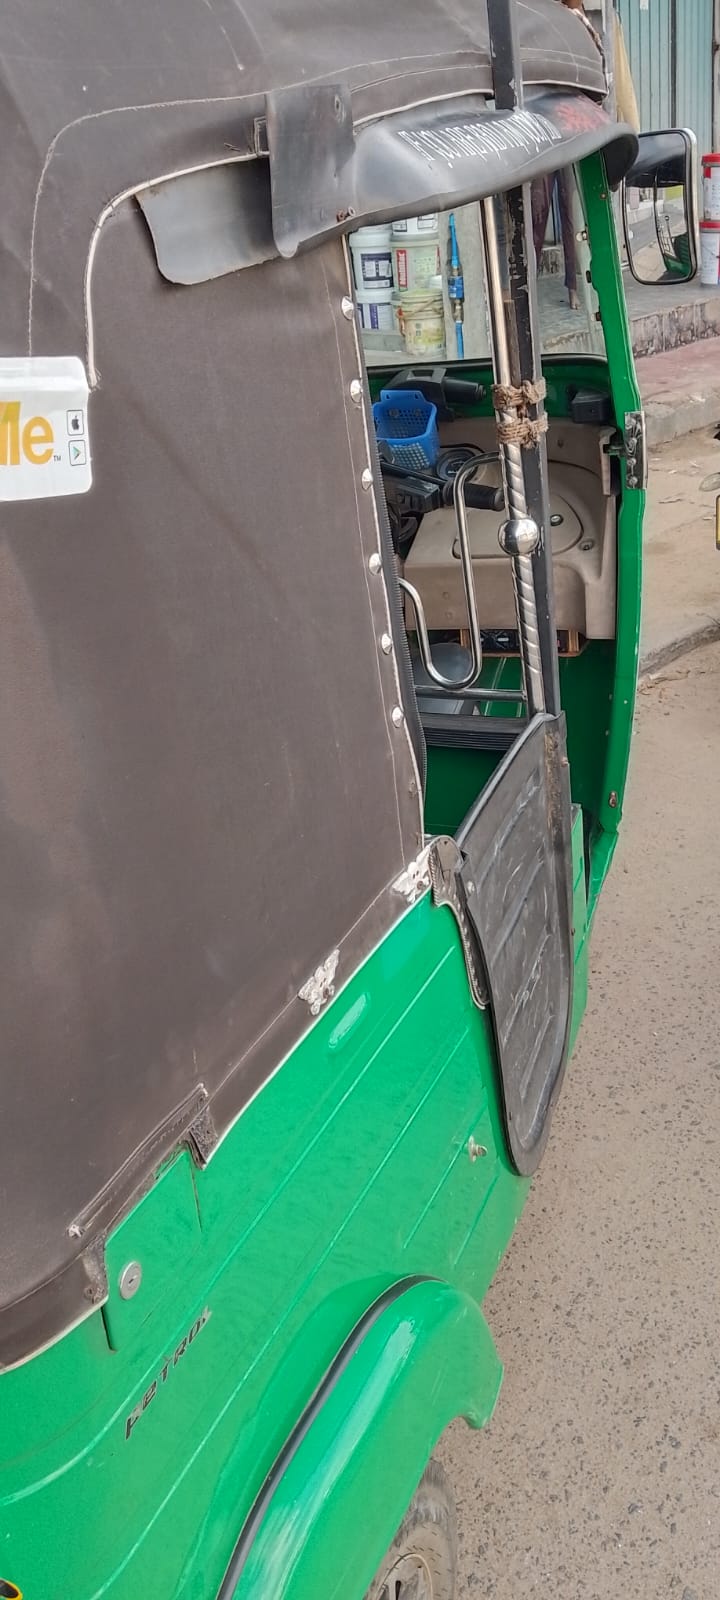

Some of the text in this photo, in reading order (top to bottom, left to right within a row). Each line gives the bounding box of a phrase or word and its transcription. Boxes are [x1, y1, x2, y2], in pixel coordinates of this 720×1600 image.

[397, 130, 435, 161] IF
[411, 130, 461, 168] YOU
[439, 126, 488, 162] ARE
[464, 122, 507, 160] BAD
